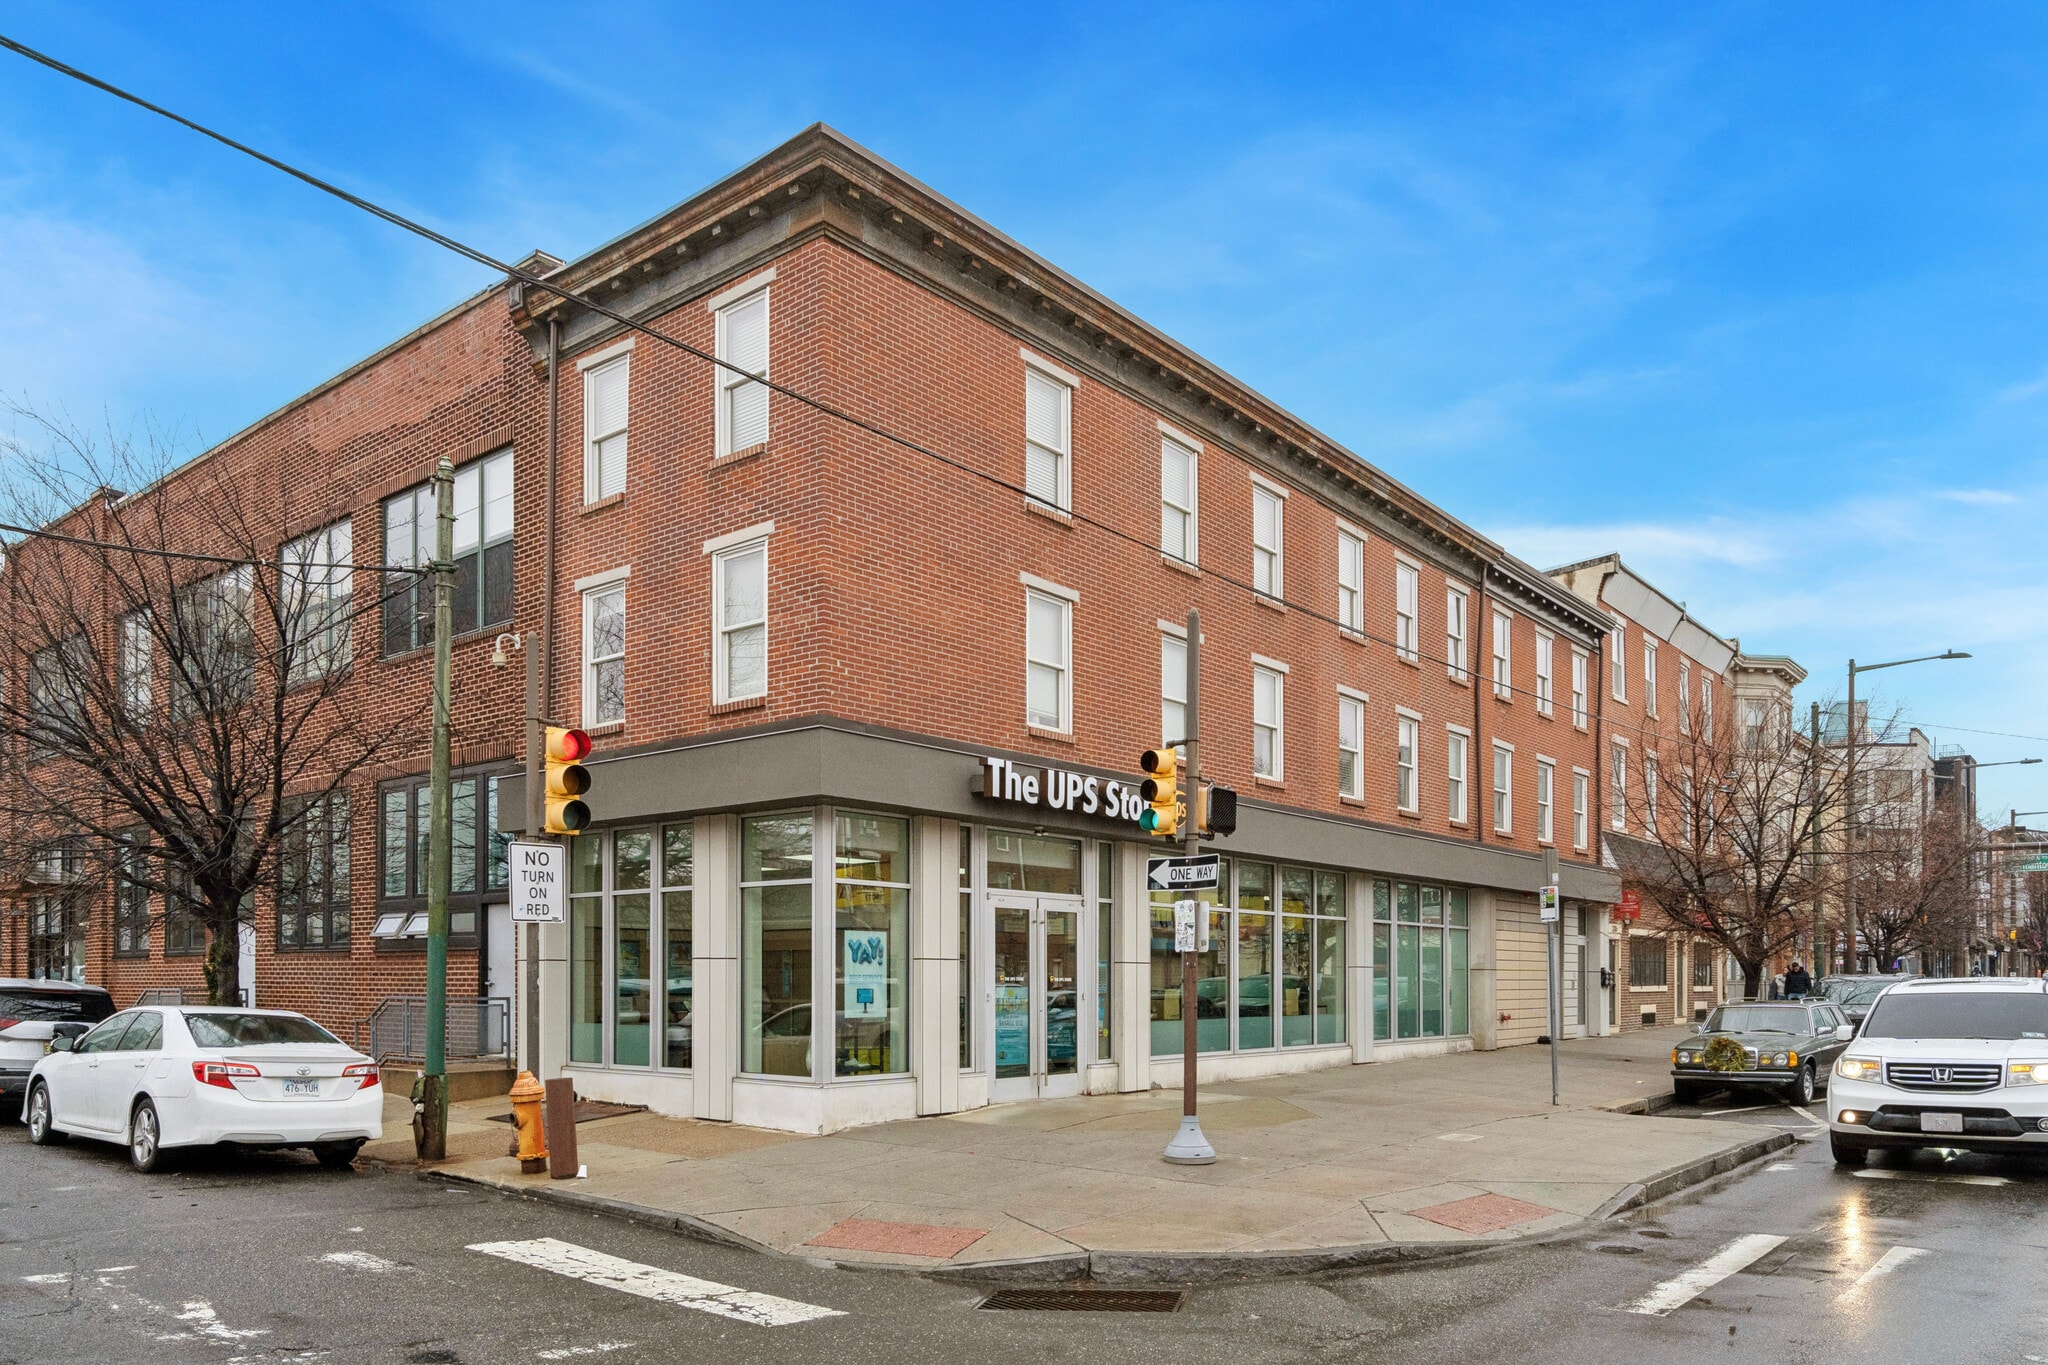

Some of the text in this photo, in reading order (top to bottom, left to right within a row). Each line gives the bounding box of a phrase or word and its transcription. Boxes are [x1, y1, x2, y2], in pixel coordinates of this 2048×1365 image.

[987, 757, 1039, 804] The
[1047, 769, 1098, 814] UPS
[525, 851, 550, 866] NO
[521, 870, 554, 883] TURN
[1170, 866, 1214, 880] ONE WAY
[529, 887, 547, 899] ON
[526, 903, 550, 916] RED
[848, 936, 884, 966] YAY!
[285, 1084, 319, 1092] 476 YUH
